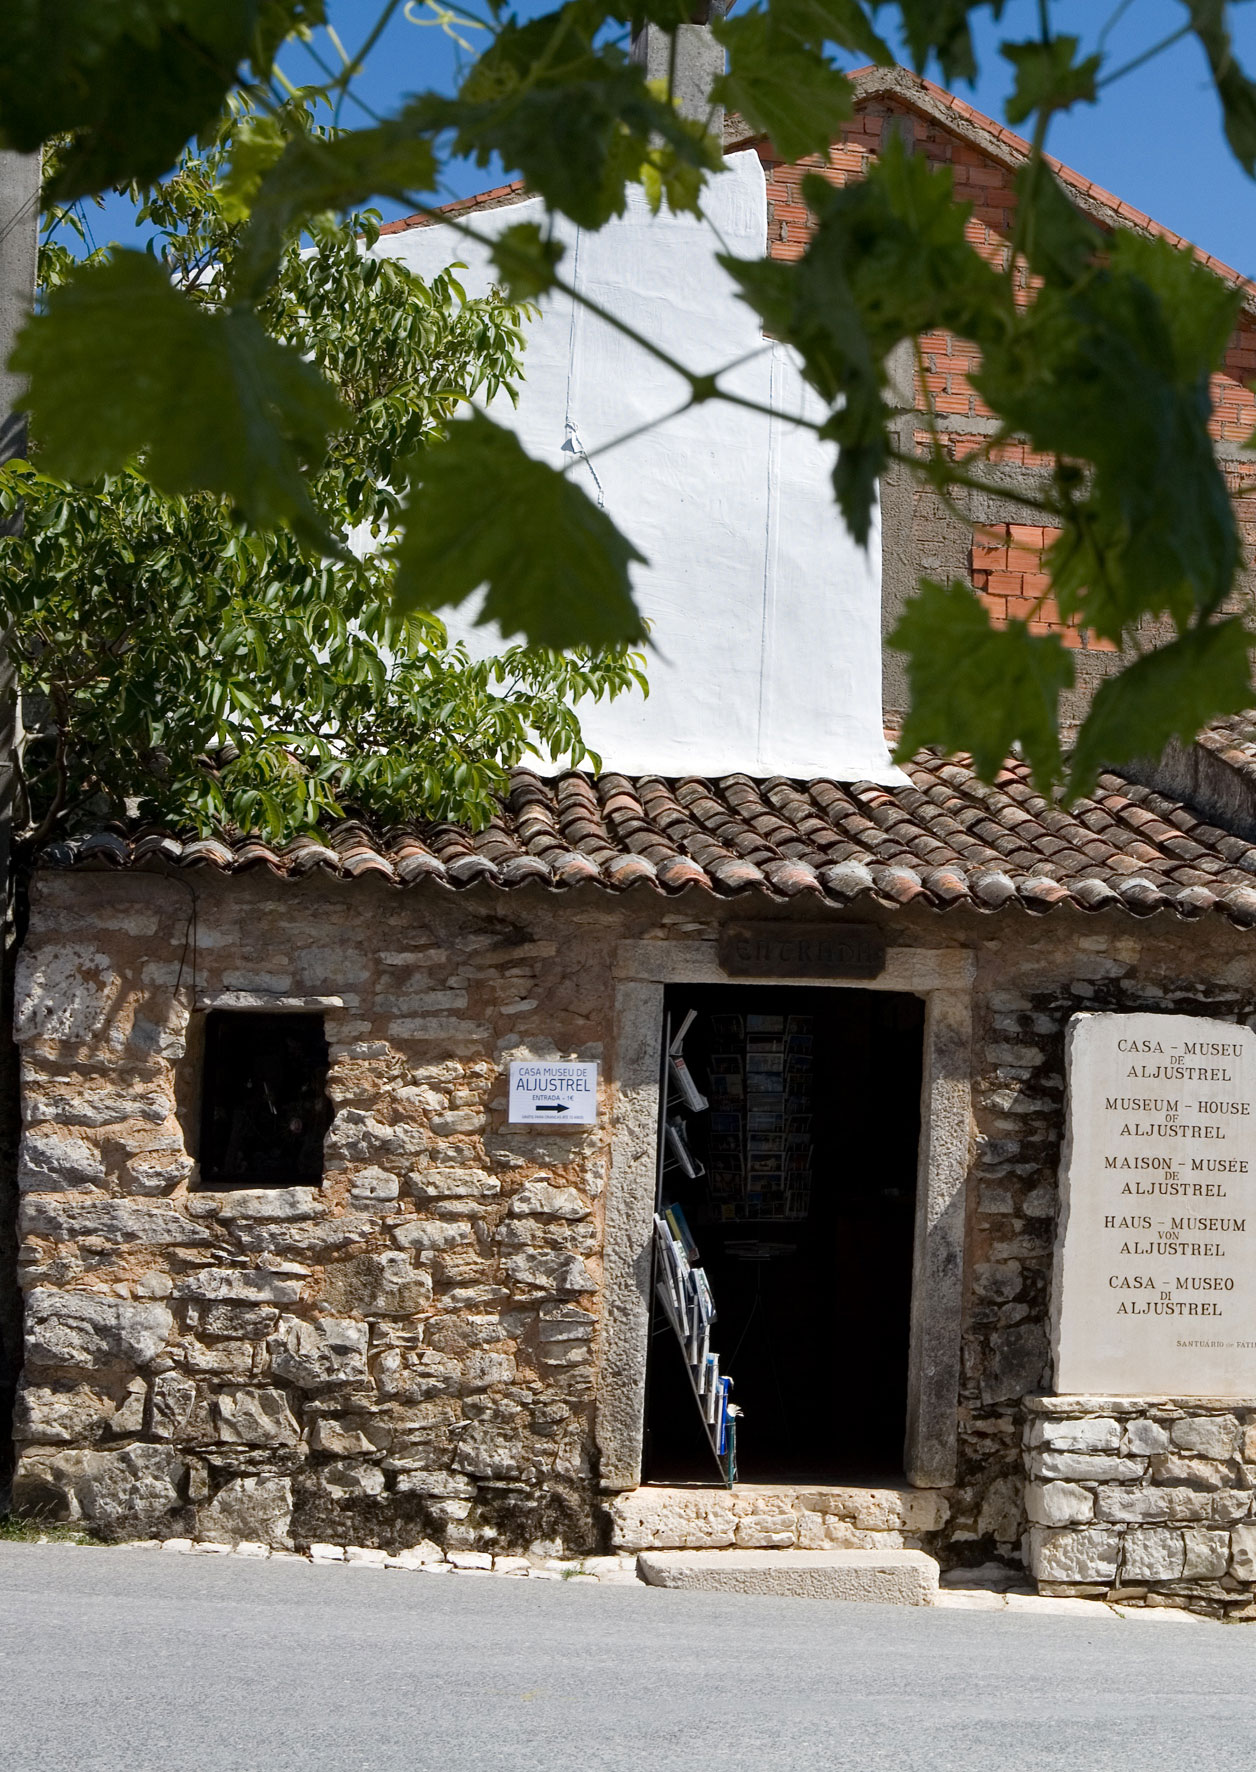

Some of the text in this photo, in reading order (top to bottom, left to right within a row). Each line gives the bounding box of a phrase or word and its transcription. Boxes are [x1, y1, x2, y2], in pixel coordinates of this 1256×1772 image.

[1117, 1040, 1164, 1054] CASA
[1184, 1042, 1244, 1057] MUSEU
[1170, 1056, 1185, 1065] DE
[519, 1068, 587, 1077] CASA MUSEU DE
[1127, 1065, 1231, 1082] ALJUSTREL
[516, 1078, 590, 1091] ALJUSTREL
[1105, 1097, 1179, 1112] MUSEUM
[1198, 1101, 1250, 1115] HOUSE
[1165, 1114, 1179, 1123] OF
[1120, 1124, 1225, 1140] ALJUSTREL
[1104, 1157, 1172, 1170] MAISON
[1191, 1157, 1249, 1173] MUSÉE
[1165, 1172, 1179, 1180] DE
[1121, 1182, 1226, 1197] ALJUSTREL
[1104, 1216, 1152, 1229] HAUS
[1170, 1217, 1247, 1232] MUSEUM
[1158, 1231, 1179, 1240] VON
[1120, 1242, 1225, 1257] ALJUSTREL
[1109, 1276, 1156, 1289] CASA
[1176, 1277, 1234, 1290] MUSEO
[1160, 1292, 1171, 1301] DI
[1116, 1302, 1222, 1316] ALJUSTREL
